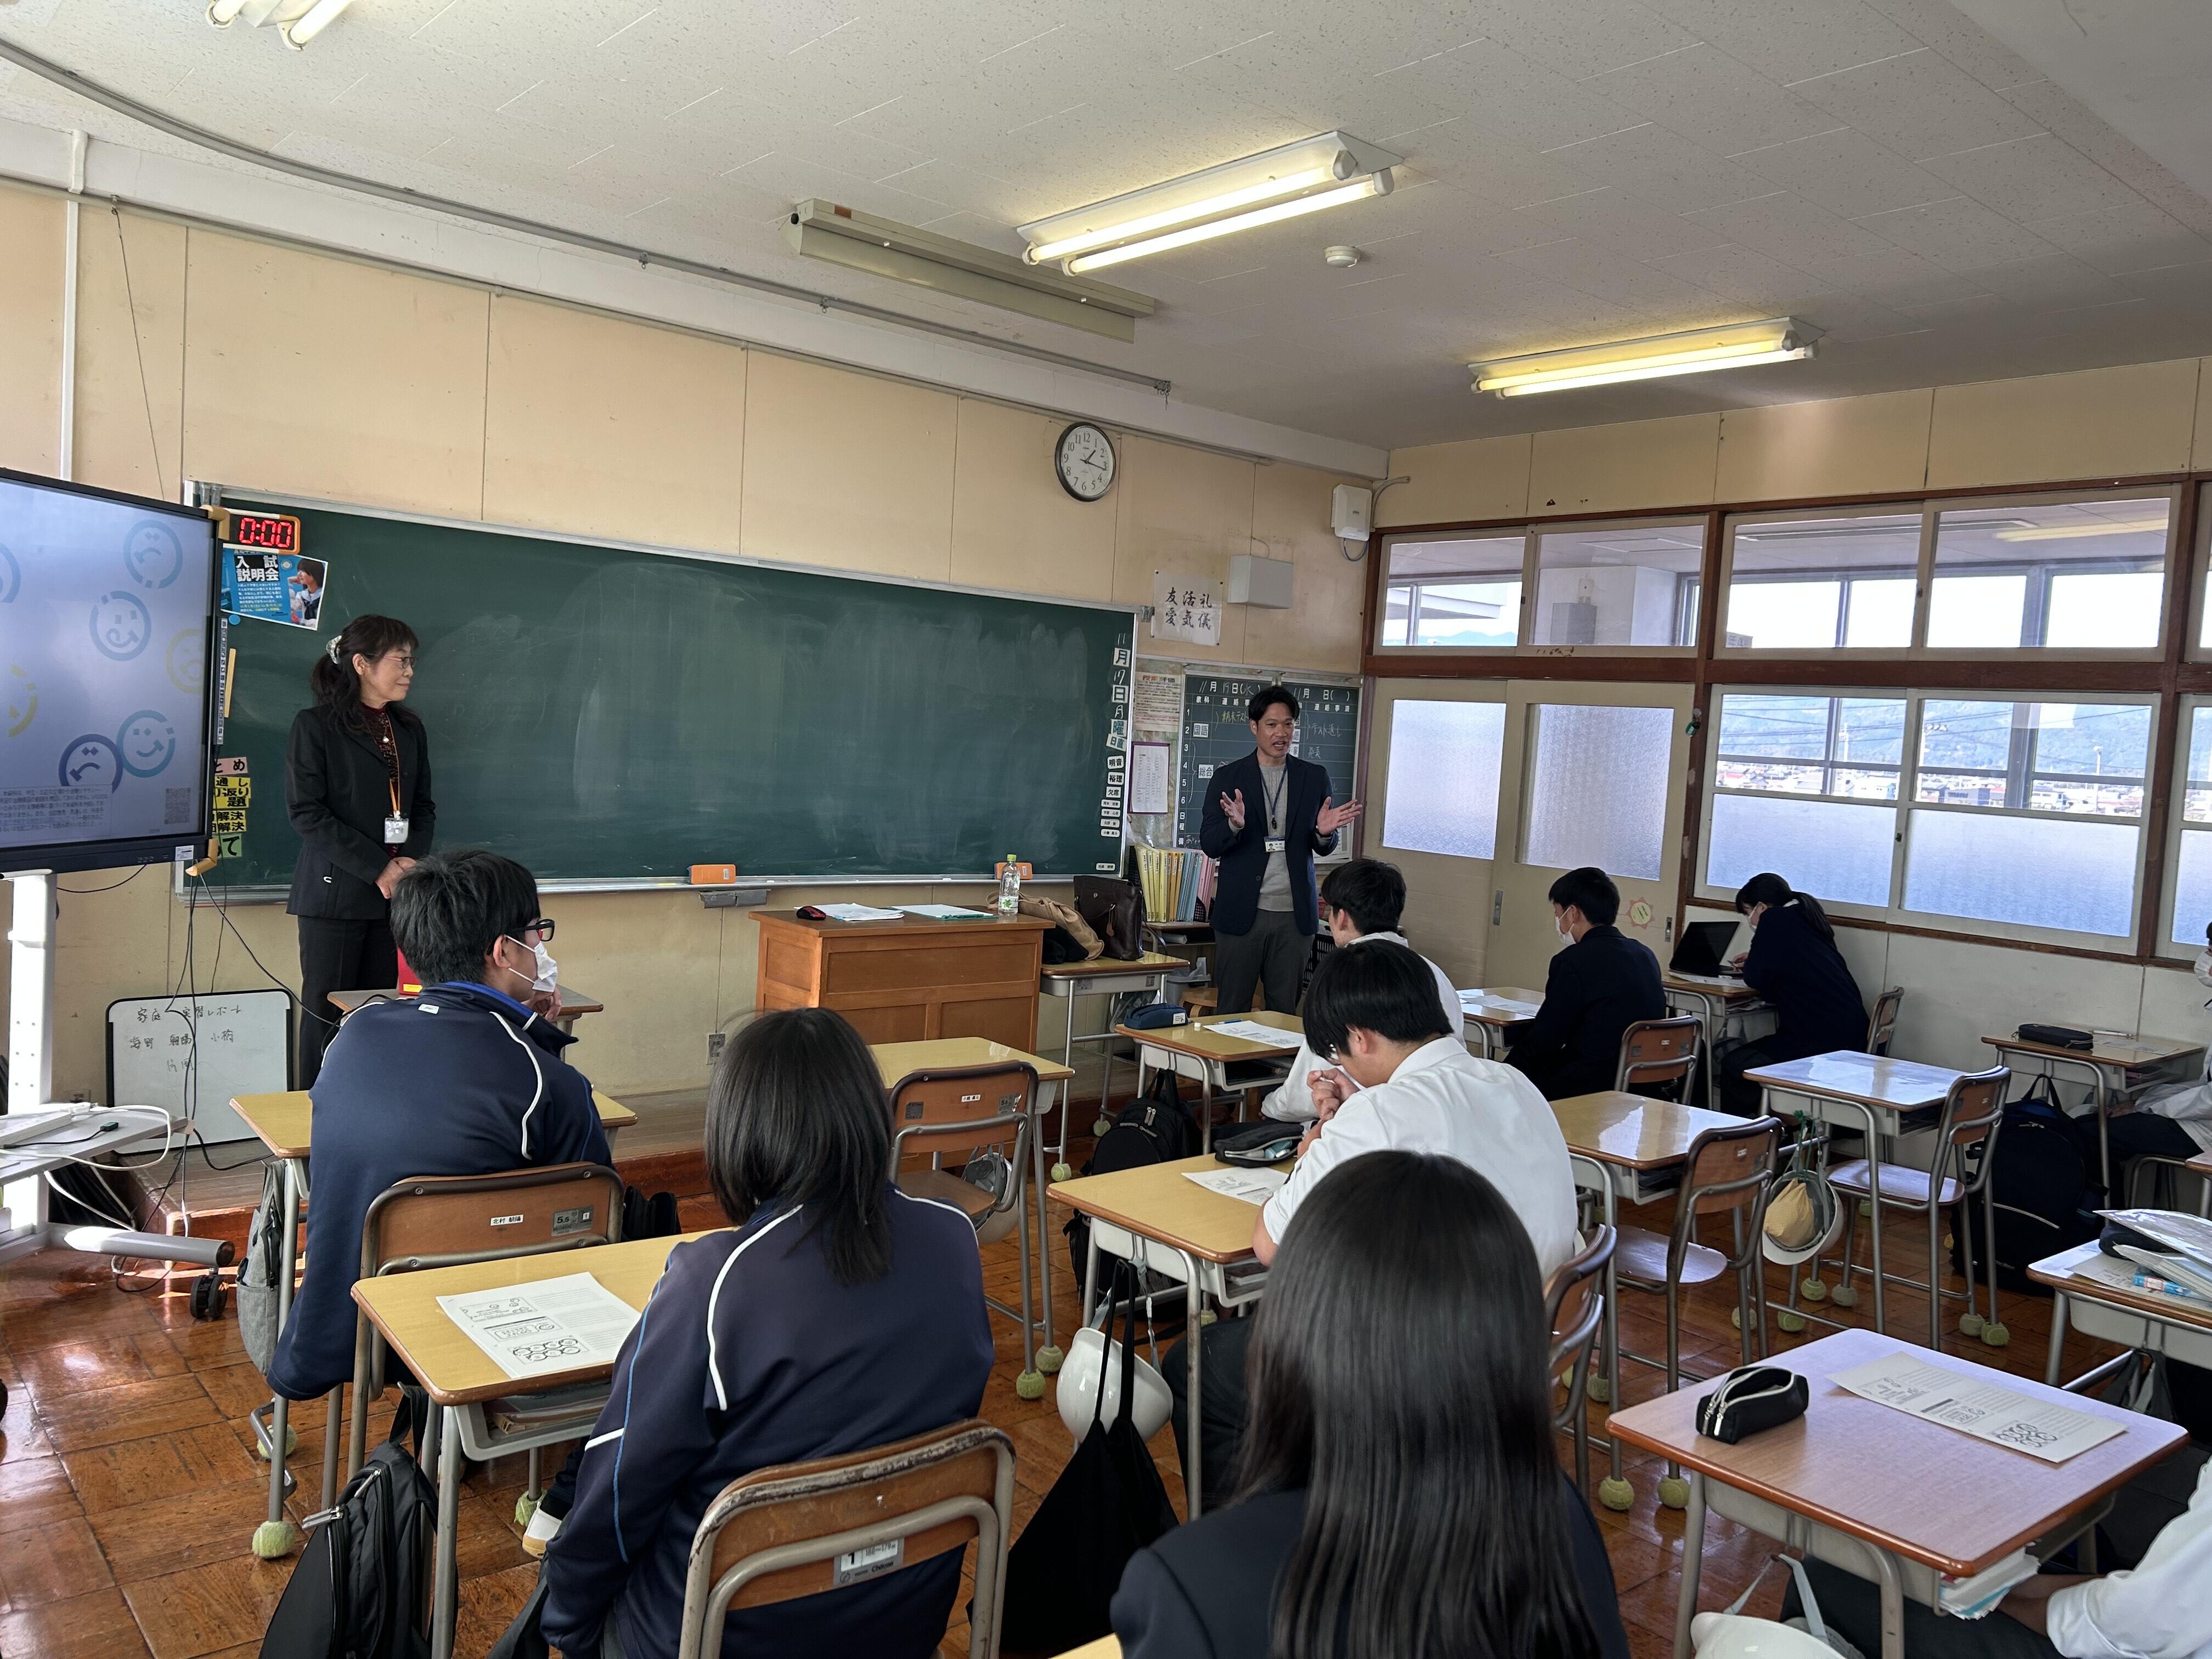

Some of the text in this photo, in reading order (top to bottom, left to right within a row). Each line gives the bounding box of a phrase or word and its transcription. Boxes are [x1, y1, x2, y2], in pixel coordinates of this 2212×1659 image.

[1075, 434, 1081, 444] 11
[1084, 432, 1091, 443] 12
[1068, 442, 1075, 452] 10
[1094, 438, 1098, 448] 1
[1064, 453, 1069, 462] 9
[1100, 448, 1104, 458] 2
[1066, 466, 1071, 476] 8
[1103, 461, 1107, 471] 3
[1074, 477, 1079, 486] 7
[1098, 473, 1102, 483] 4
[1081, 481, 1086, 491] 6
[1092, 480, 1096, 490] 5
[239, 517, 292, 548] 0:00
[236, 568, 279, 582] 説明会
[1165, 586, 1178, 627] 友愛
[1182, 591, 1197, 628] 活気
[1198, 594, 1212, 630] 礼儀
[1222, 697, 1250, 707] 連絡事
[1185, 726, 1189, 734] 2
[1194, 724, 1208, 736] 国語
[1312, 722, 1341, 738] テスト返し
[1110, 736, 1124, 749] 日直
[1307, 746, 1321, 760] 発表
[215, 759, 245, 774] とめ
[1199, 767, 1213, 777] 総合
[1181, 796, 1186, 804] 6
[213, 811, 244, 821] 解決
[137, 1007, 161, 1023] 家庭
[848, 1552, 855, 1565] 1
